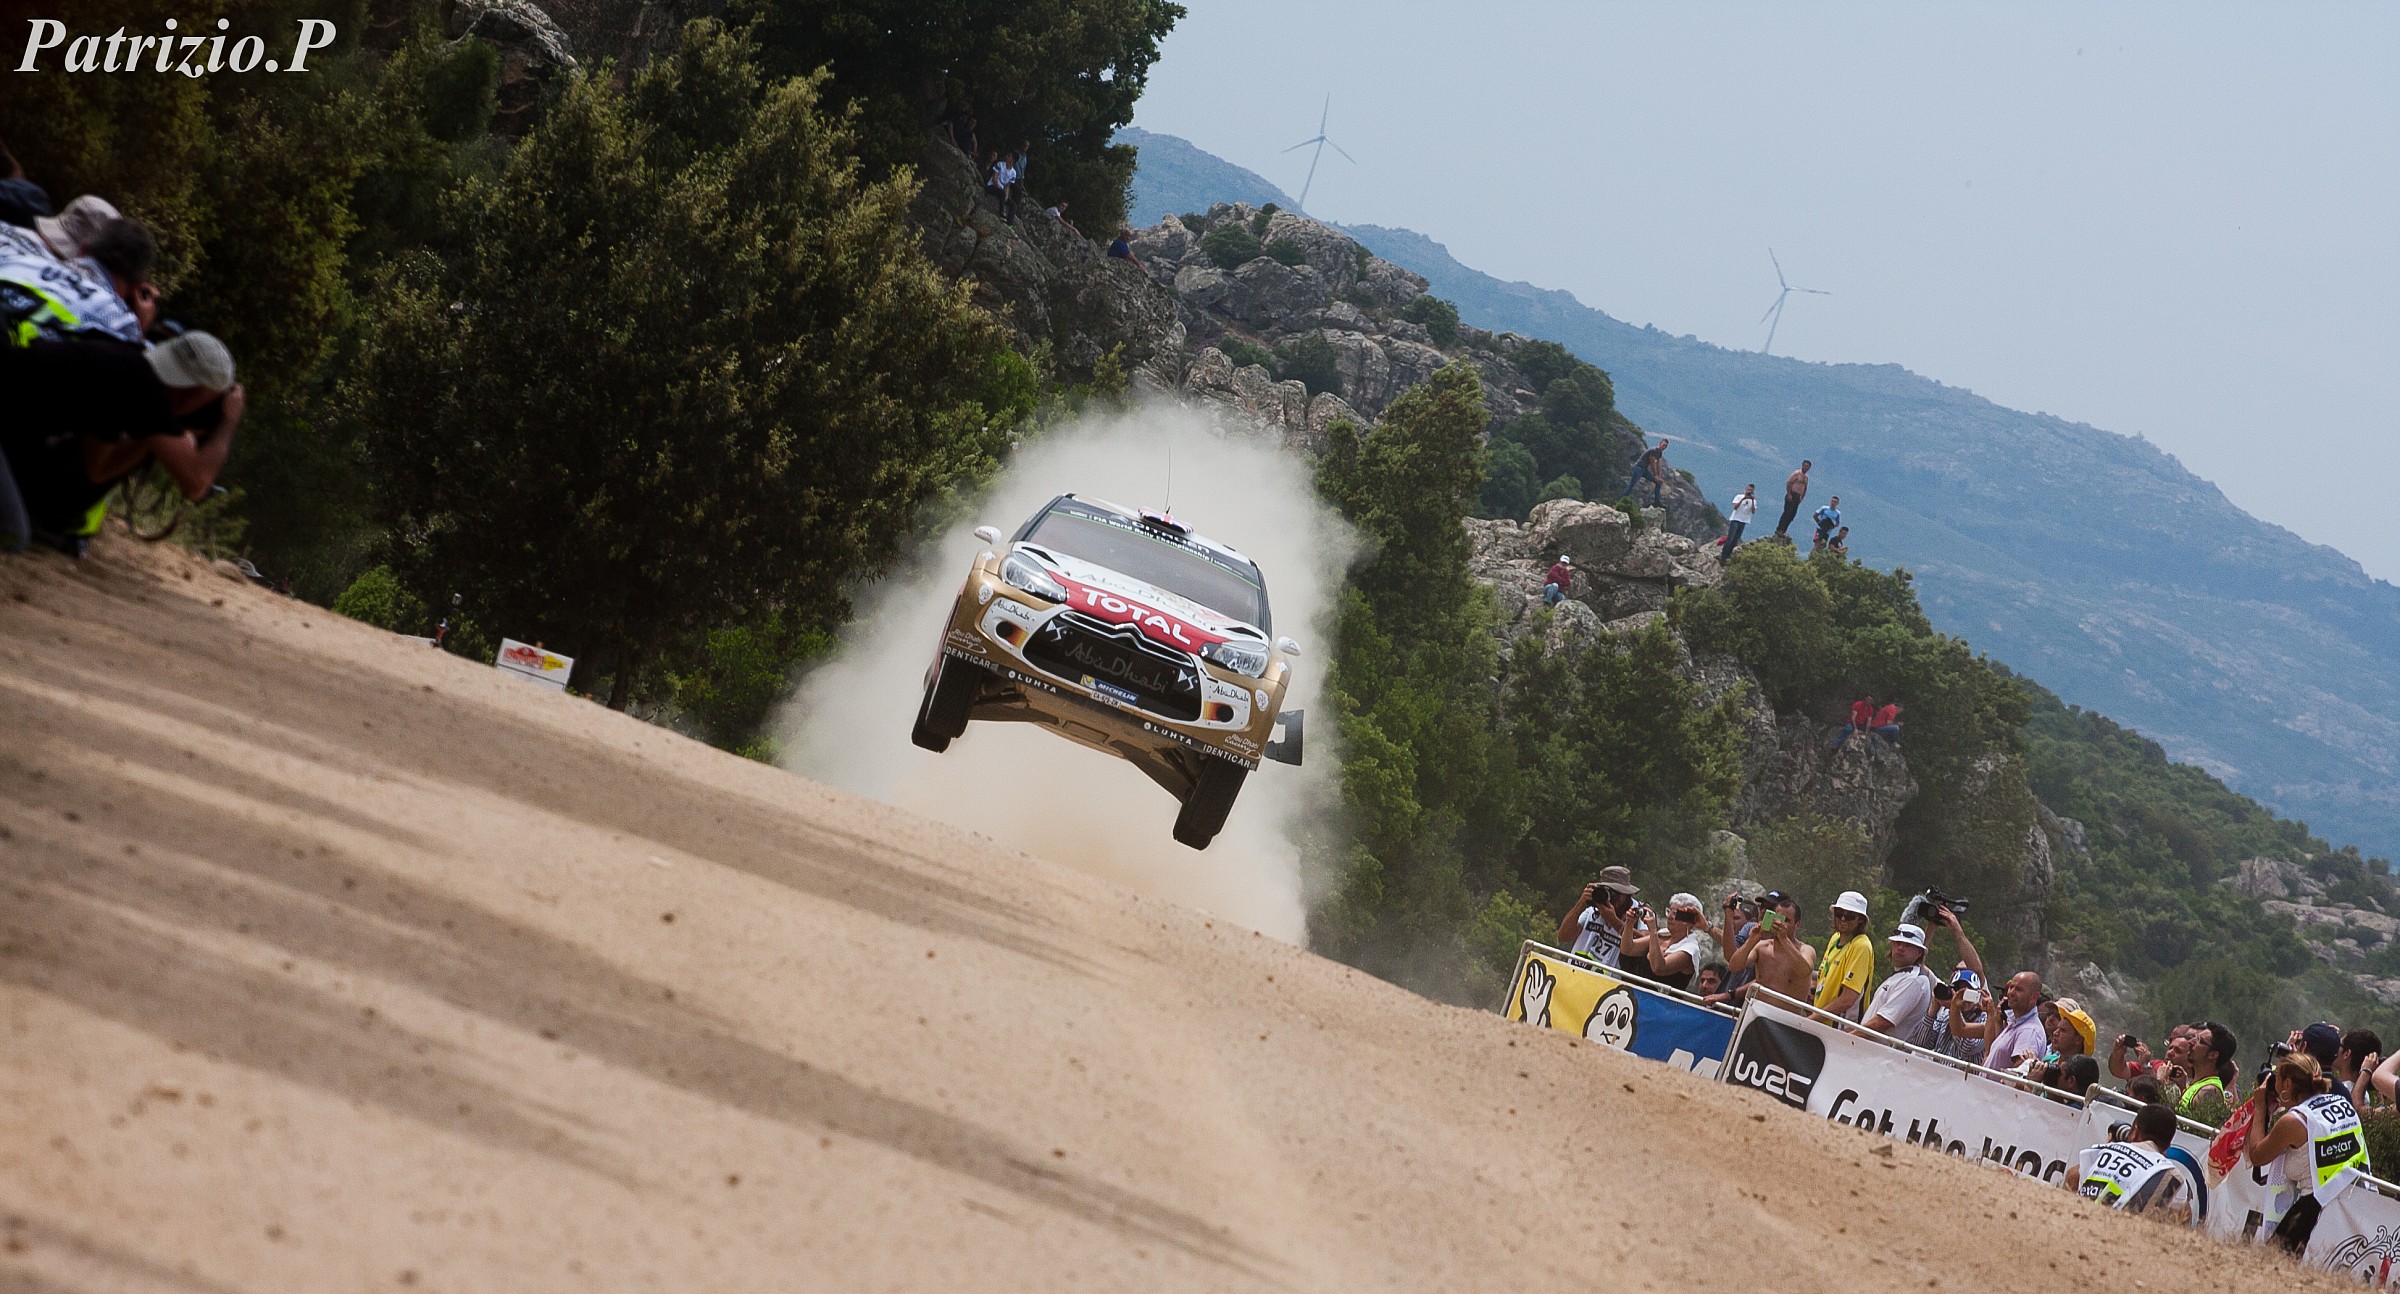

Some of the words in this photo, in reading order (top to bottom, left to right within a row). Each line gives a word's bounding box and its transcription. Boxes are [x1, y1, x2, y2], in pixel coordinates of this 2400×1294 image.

[1109, 519, 1133, 531] World
[1134, 527, 1154, 538] Rally
[1081, 587, 1191, 645] TOTAL
[943, 645, 992, 669] IDENTICAR
[1017, 673, 1057, 693] LUHTA
[1098, 683, 1136, 702] MICHELIN
[1153, 725, 1192, 745] LUHTA
[1203, 743, 1251, 769] IDENTICAR
[1735, 1052, 1812, 1104] WRC
[2321, 1101, 2355, 1124] 098
[2320, 1140, 2352, 1157] Lexar
[2097, 1152, 2137, 1178] 056
